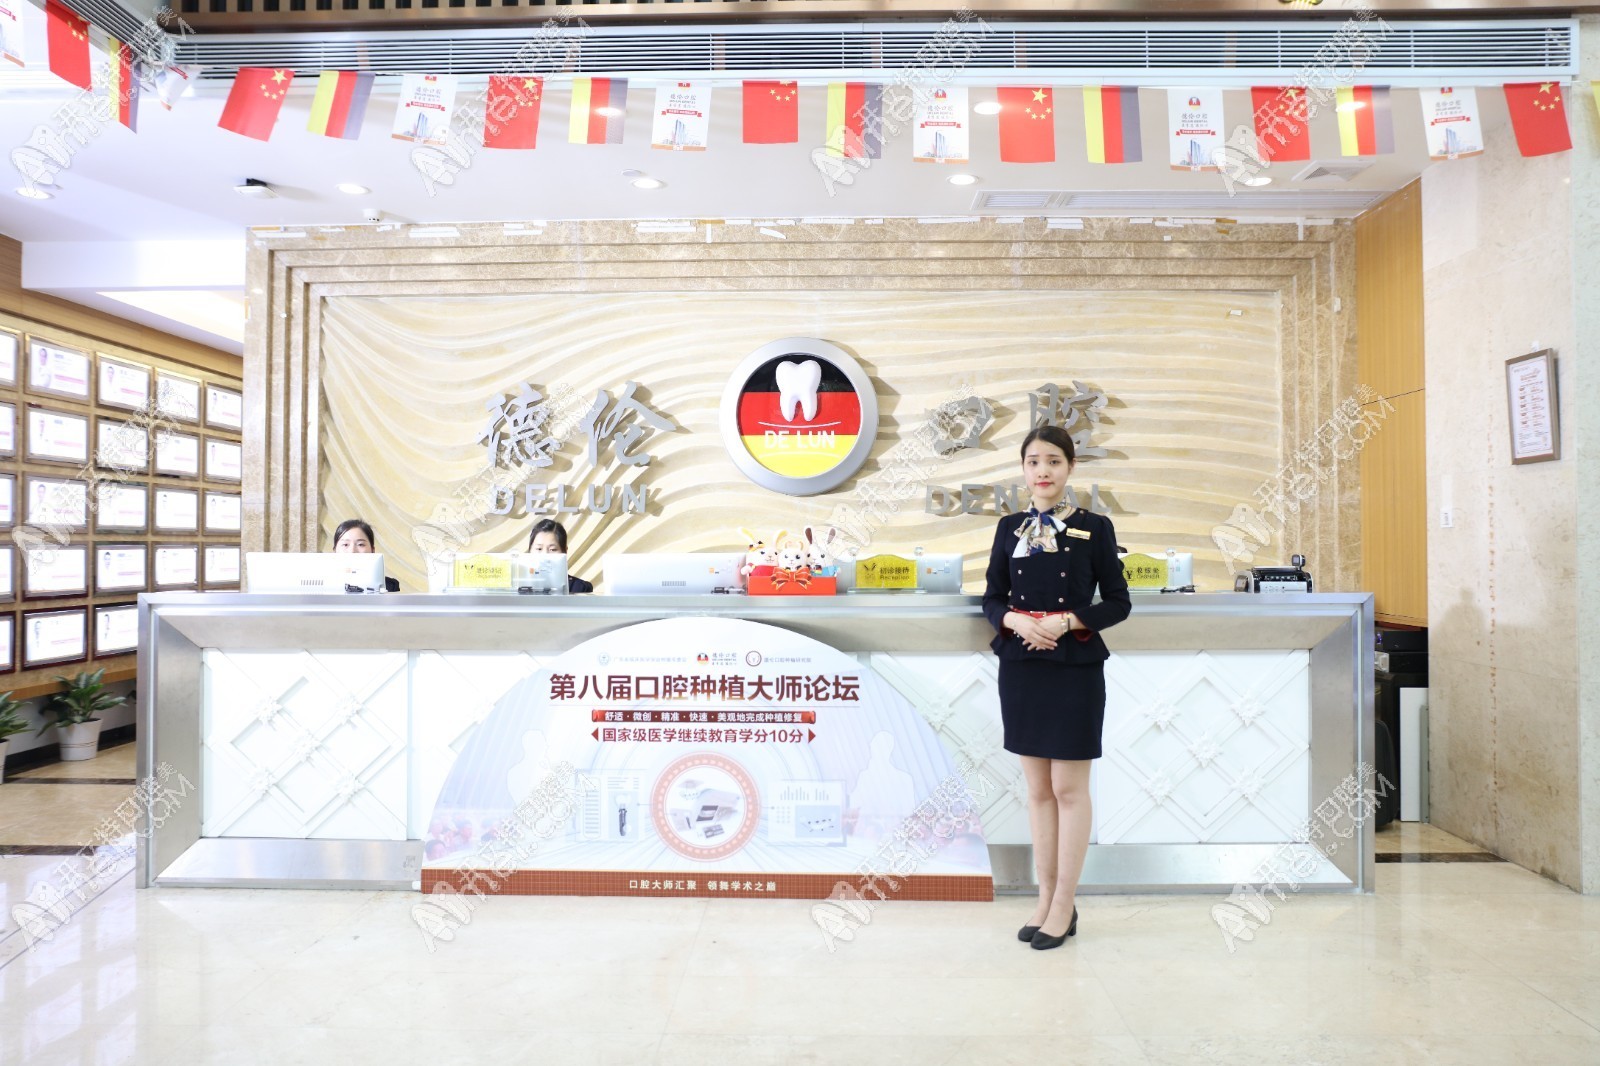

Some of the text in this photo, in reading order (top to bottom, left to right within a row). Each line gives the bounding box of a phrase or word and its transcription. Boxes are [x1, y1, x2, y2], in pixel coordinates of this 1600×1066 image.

[764, 430, 836, 449] DE LUN
[491, 483, 648, 514] DELUN
[925, 483, 1112, 514] DENAL
[549, 673, 860, 703] 第八届口腔种植大师论坛
[602, 727, 804, 744] 国家级医学继续教育学分10分
[628, 879, 778, 892] 口腔大师汇聚 领舞学术之巅
